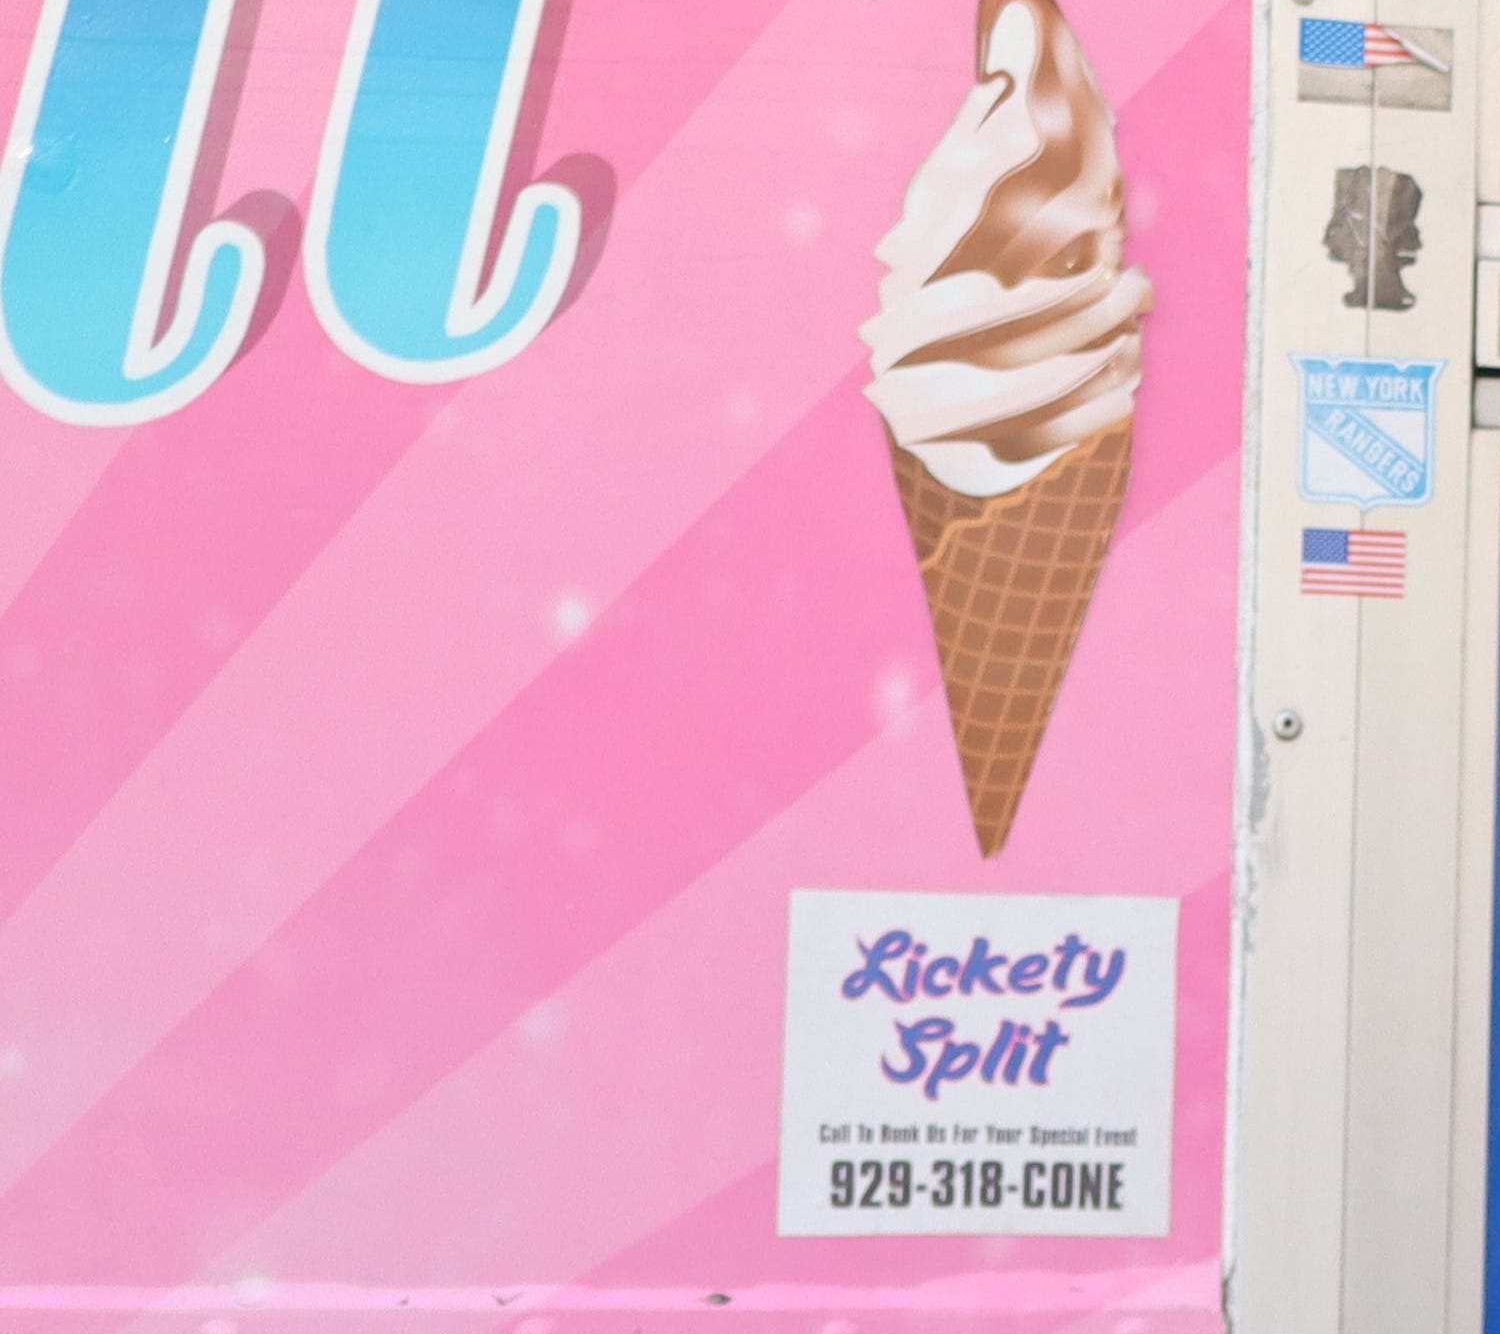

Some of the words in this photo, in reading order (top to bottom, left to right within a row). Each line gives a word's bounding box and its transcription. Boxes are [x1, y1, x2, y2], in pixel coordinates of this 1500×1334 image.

[1307, 374, 1360, 401] NEW
[1366, 375, 1426, 404] YORK
[1325, 410, 1421, 494] RANGERS
[842, 930, 1126, 1009] Lickety
[881, 1018, 1069, 1101] Split
[819, 1124, 850, 1144] Call
[858, 1125, 874, 1144] To
[927, 1125, 946, 1144] Us
[953, 1126, 978, 1145] For
[986, 1127, 1022, 1145] Your
[1030, 1127, 1089, 1149] Special
[1095, 1128, 1138, 1146] Event
[830, 1160, 1125, 1210] 929-318-CONE
